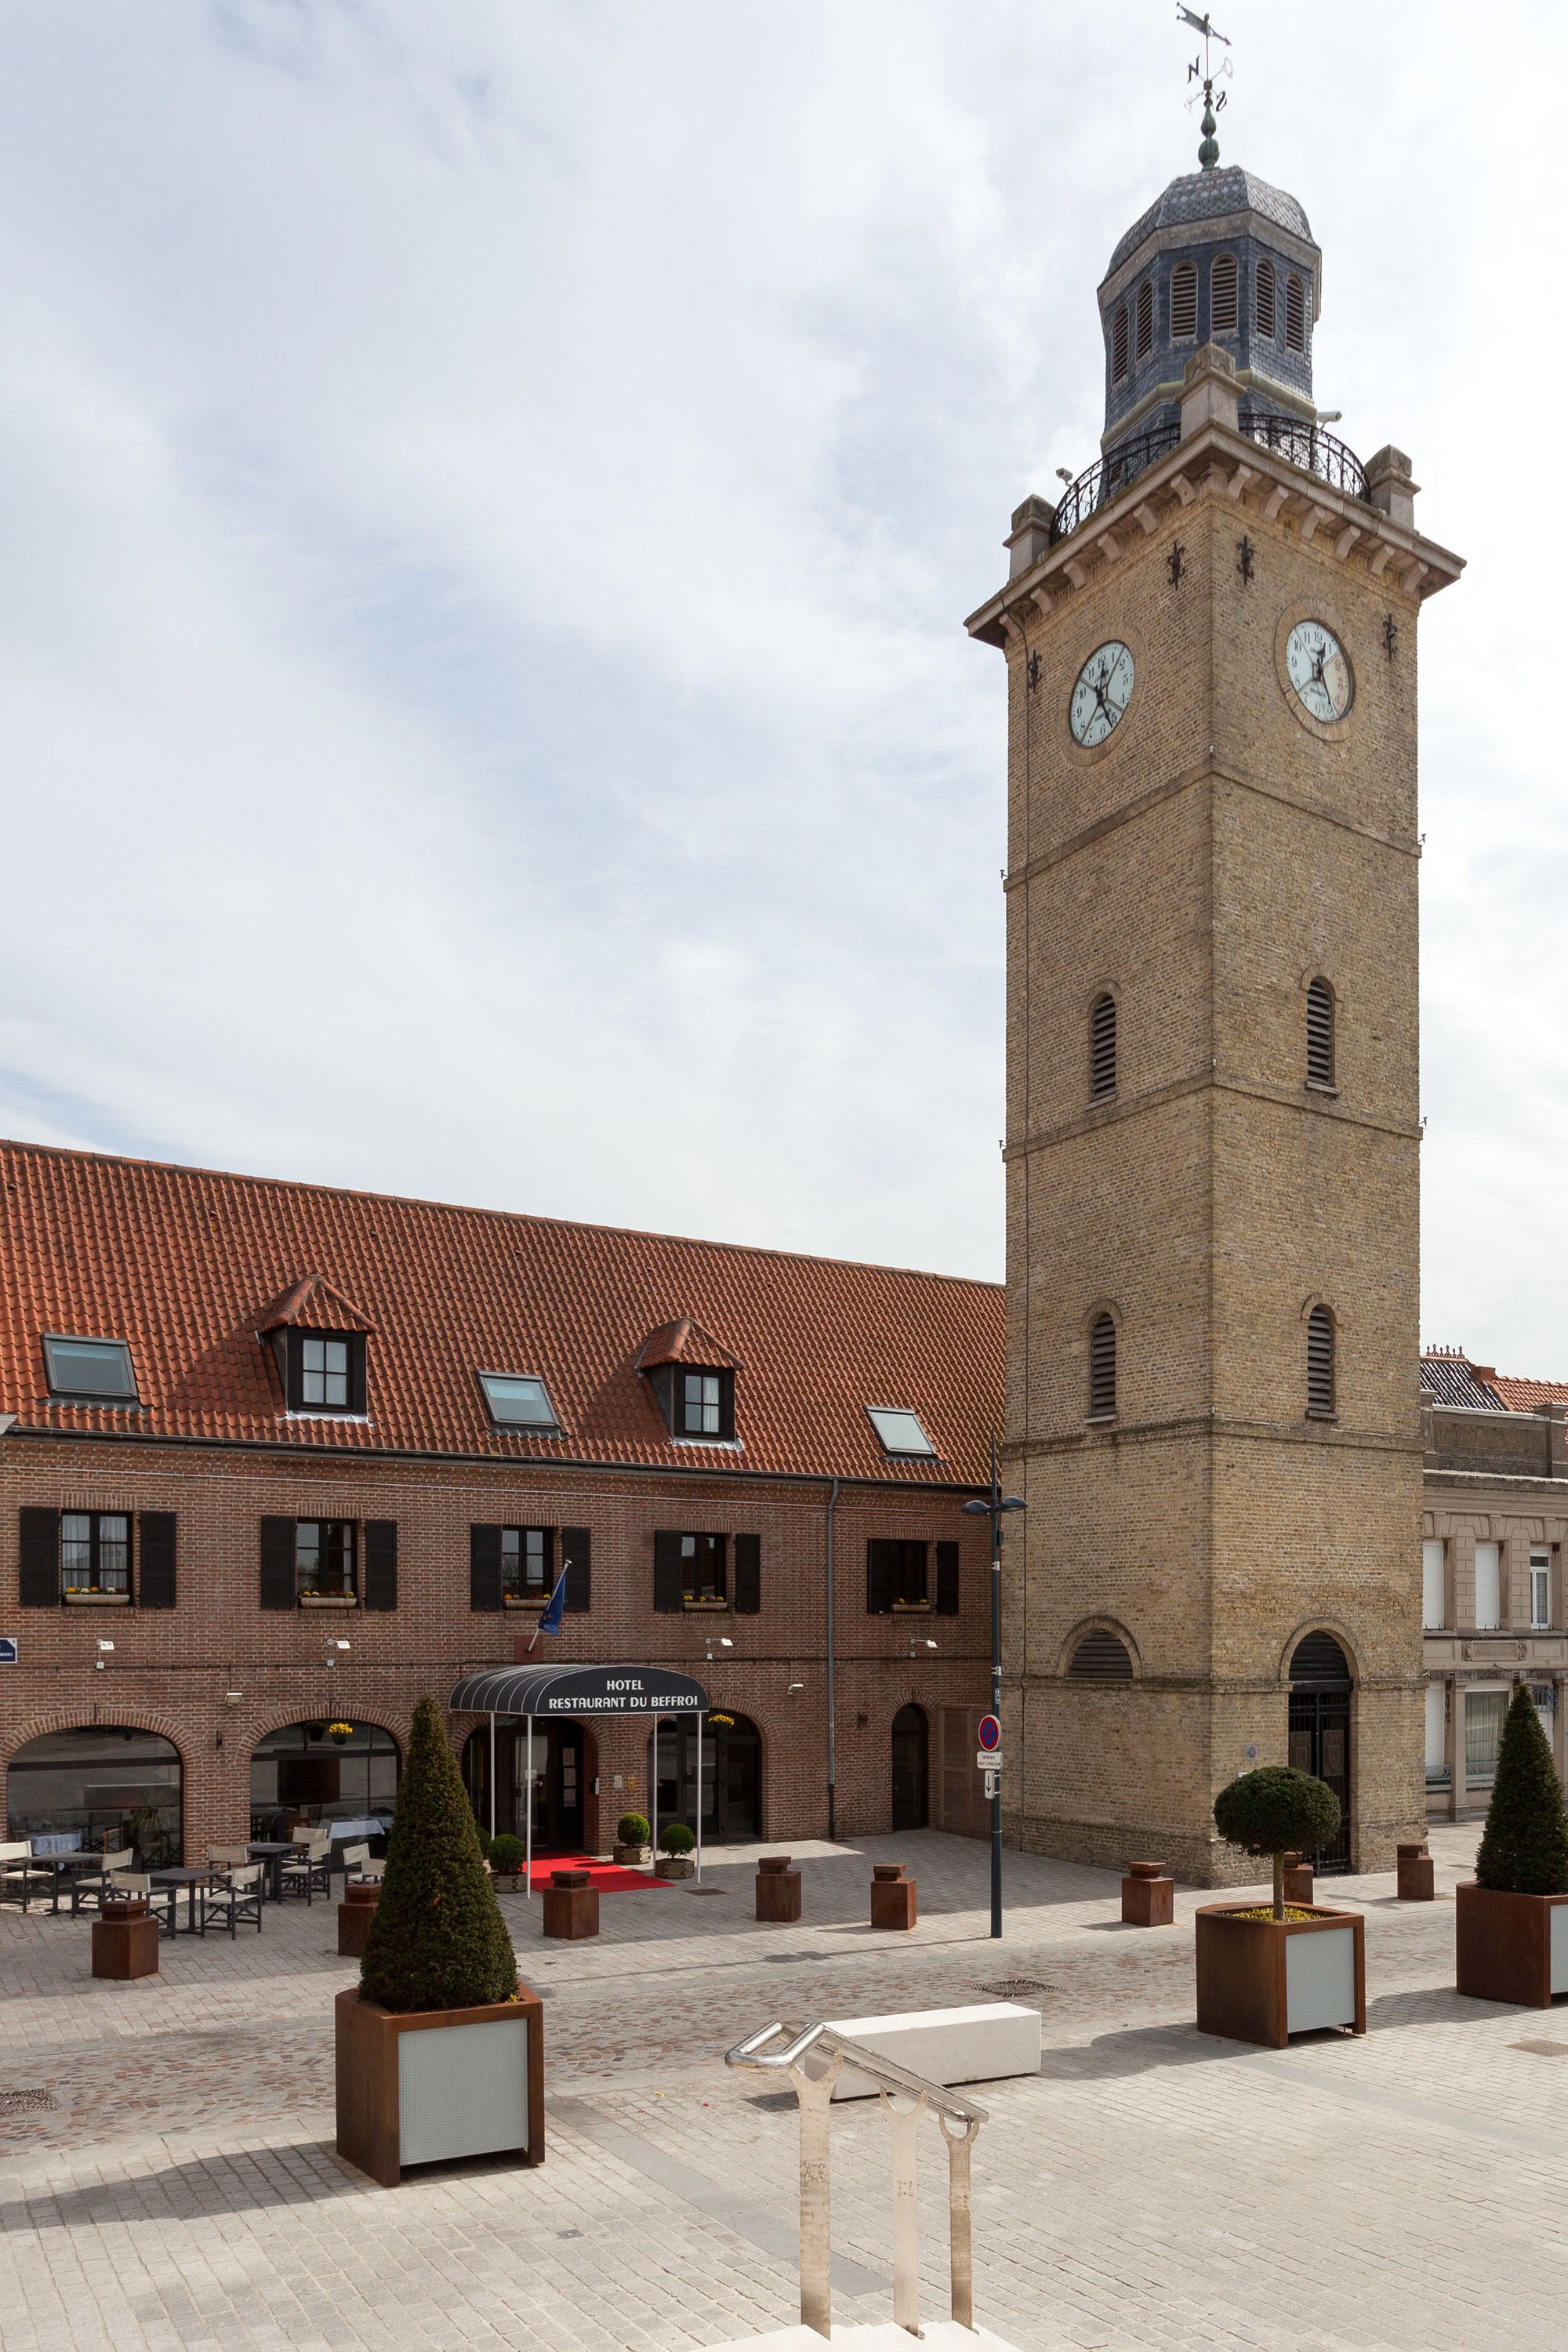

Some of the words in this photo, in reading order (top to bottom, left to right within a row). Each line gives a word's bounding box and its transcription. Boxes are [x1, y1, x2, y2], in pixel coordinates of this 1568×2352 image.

[1187, 54, 1200, 84] N
[1304, 631, 1310, 643] 11
[1314, 630, 1323, 643] 12
[1294, 639, 1301, 653] 10
[1088, 666, 1094, 680] 11
[1080, 687, 1087, 700] 10
[606, 1679, 644, 1691] HOTEL
[549, 1697, 626, 1709] RESTAURANT
[630, 1696, 648, 1708] DU
[651, 1695, 699, 1707] BEFFROI
